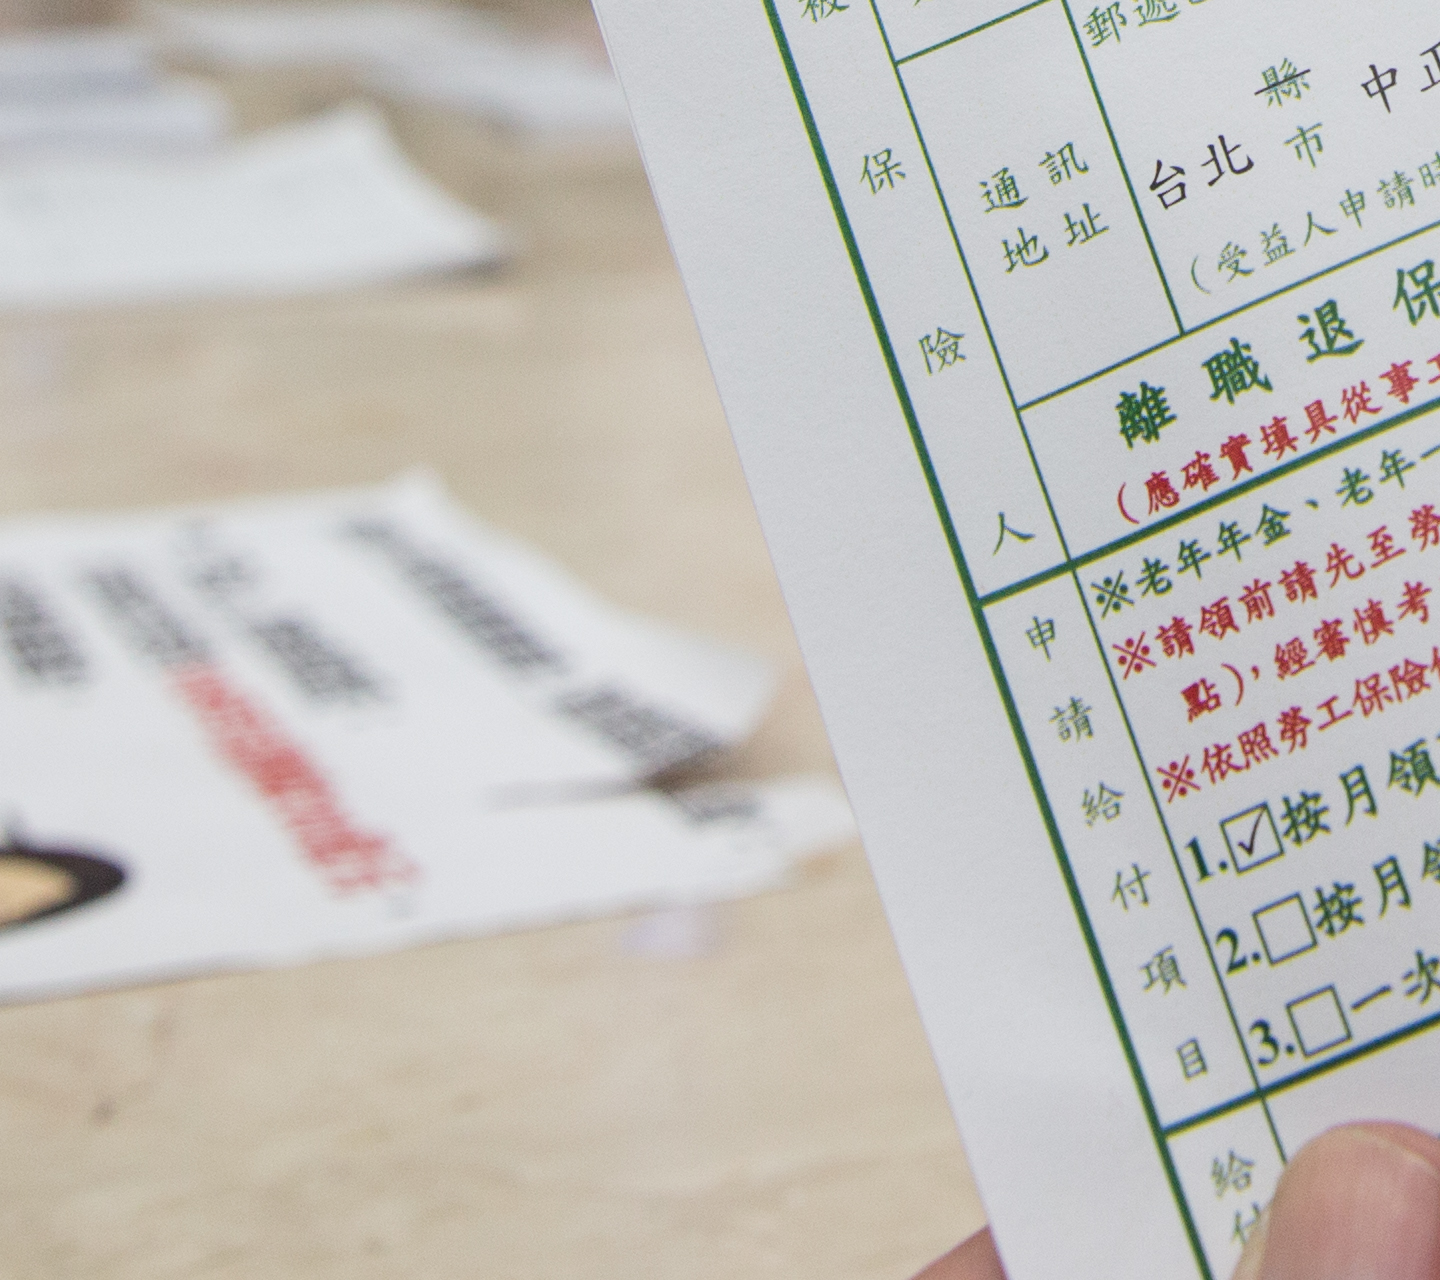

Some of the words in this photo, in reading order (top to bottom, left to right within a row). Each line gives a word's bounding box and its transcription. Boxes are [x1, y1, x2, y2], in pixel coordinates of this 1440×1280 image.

[979, 142, 1089, 214] 通訊
[1149, 135, 1254, 210] 台北
[1284, 123, 1323, 168] 市
[1001, 203, 1109, 274] 地址
